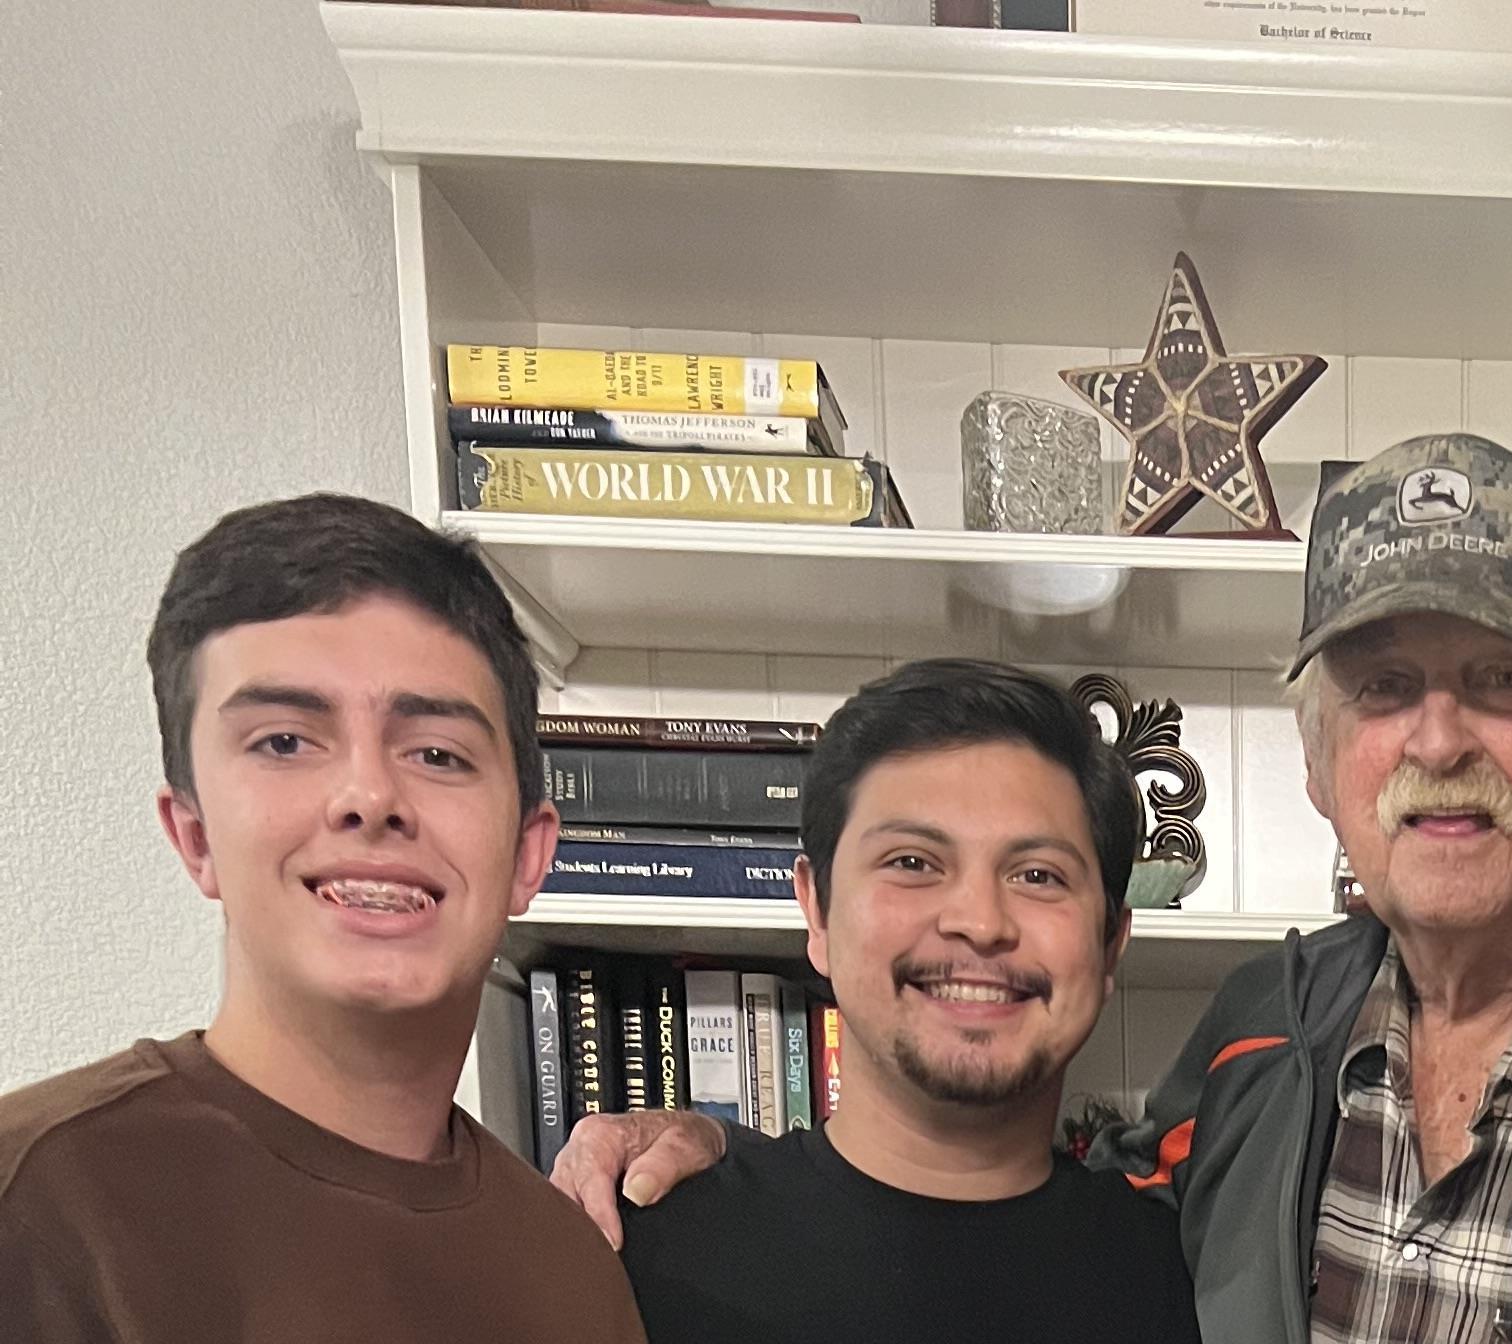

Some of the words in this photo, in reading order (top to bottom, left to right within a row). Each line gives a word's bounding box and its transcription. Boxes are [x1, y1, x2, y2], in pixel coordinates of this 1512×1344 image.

[1259, 24, 1309, 40] Bachelor
[1314, 27, 1326, 39] of
[1330, 28, 1372, 41] Science
[470, 346, 482, 362] TH
[525, 347, 537, 383] TOWE
[498, 346, 512, 400] LOOMIN
[686, 353, 700, 410] LAWRENC
[709, 365, 724, 410] WRIGHT
[471, 408, 509, 424] BRIAN
[513, 409, 574, 426] KILMEADE
[622, 415, 679, 427] THOMAS
[680, 415, 756, 429] JEFFERSON
[541, 462, 691, 501] WORLD
[701, 465, 794, 504] WAR
[806, 467, 834, 505] II
[1360, 536, 1422, 567] JOHN
[1428, 532, 1508, 559] DEERE
[535, 720, 579, 734] GDOM
[582, 721, 640, 735] WOMAN
[665, 721, 701, 733] TONY
[705, 722, 747, 734] EVANS
[601, 861, 651, 877] Learning
[652, 862, 693, 878] Library
[745, 867, 796, 880] DICTION
[579, 970, 596, 1029] BIBLE
[659, 1006, 673, 1053] DUCK
[690, 1017, 733, 1029] PILLARS
[538, 1027, 554, 1054] ON
[690, 1038, 735, 1053] GRACE
[788, 1028, 803, 1053] Six
[582, 1040, 599, 1091] CODE
[787, 1055, 804, 1092] Days
[540, 1060, 558, 1126] GUARD
[759, 1071, 775, 1129] REAG
